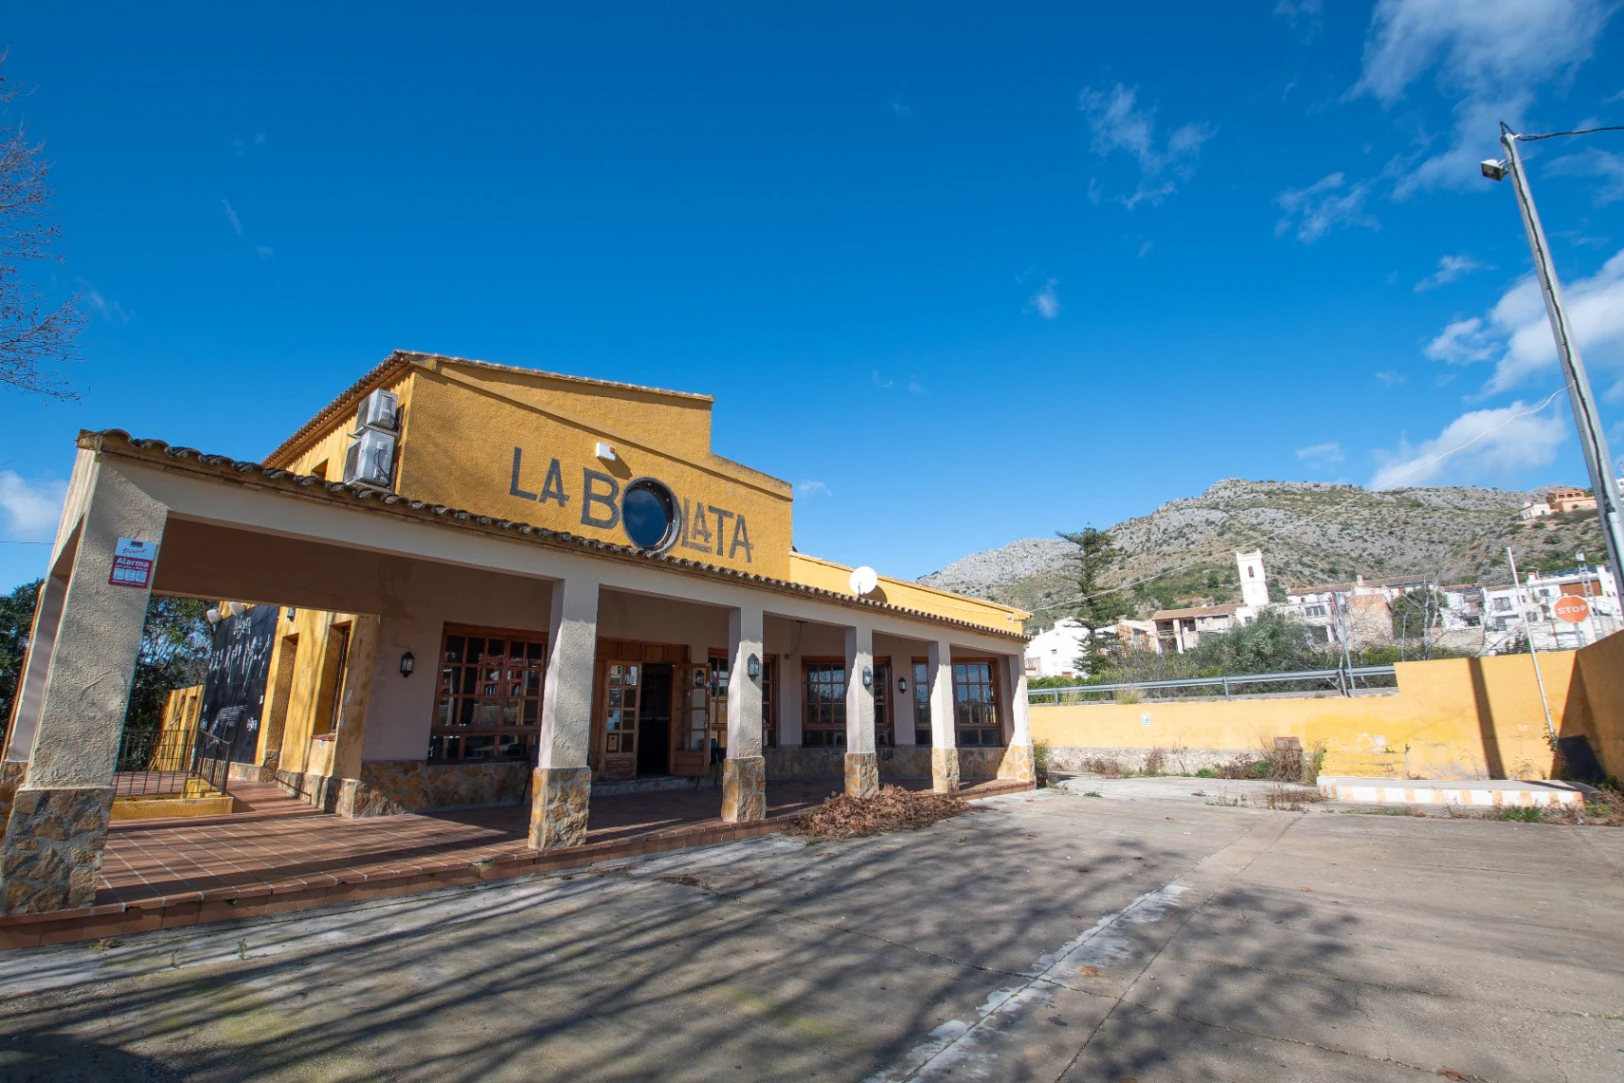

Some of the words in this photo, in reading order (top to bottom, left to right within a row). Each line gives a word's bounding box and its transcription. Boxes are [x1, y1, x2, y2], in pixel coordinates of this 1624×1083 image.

[509, 447, 570, 508] LA
[116, 557, 149, 568] Alarma
[1557, 604, 1586, 614] STOP
